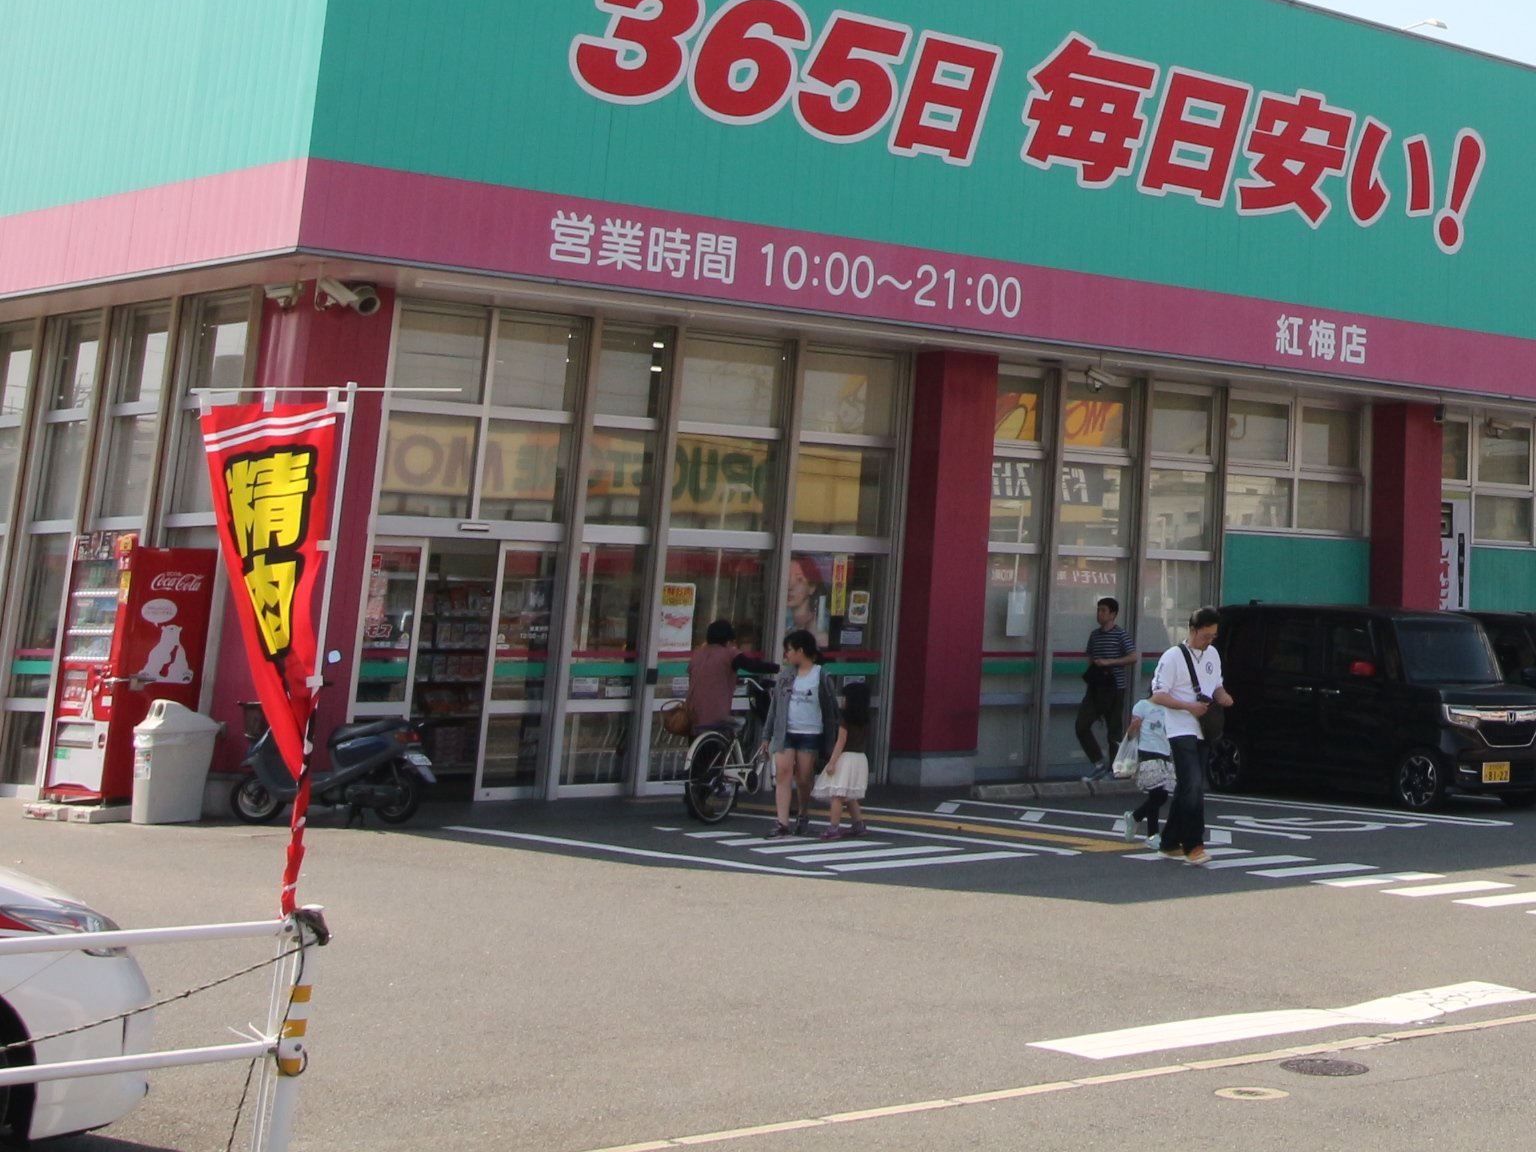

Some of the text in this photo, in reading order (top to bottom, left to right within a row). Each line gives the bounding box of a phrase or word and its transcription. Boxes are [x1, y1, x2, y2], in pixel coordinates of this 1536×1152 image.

[1021, 31, 1485, 254] 毎日安い!
[550, 210, 737, 285] 営業時間
[1275, 314, 1367, 364] 紅梅店
